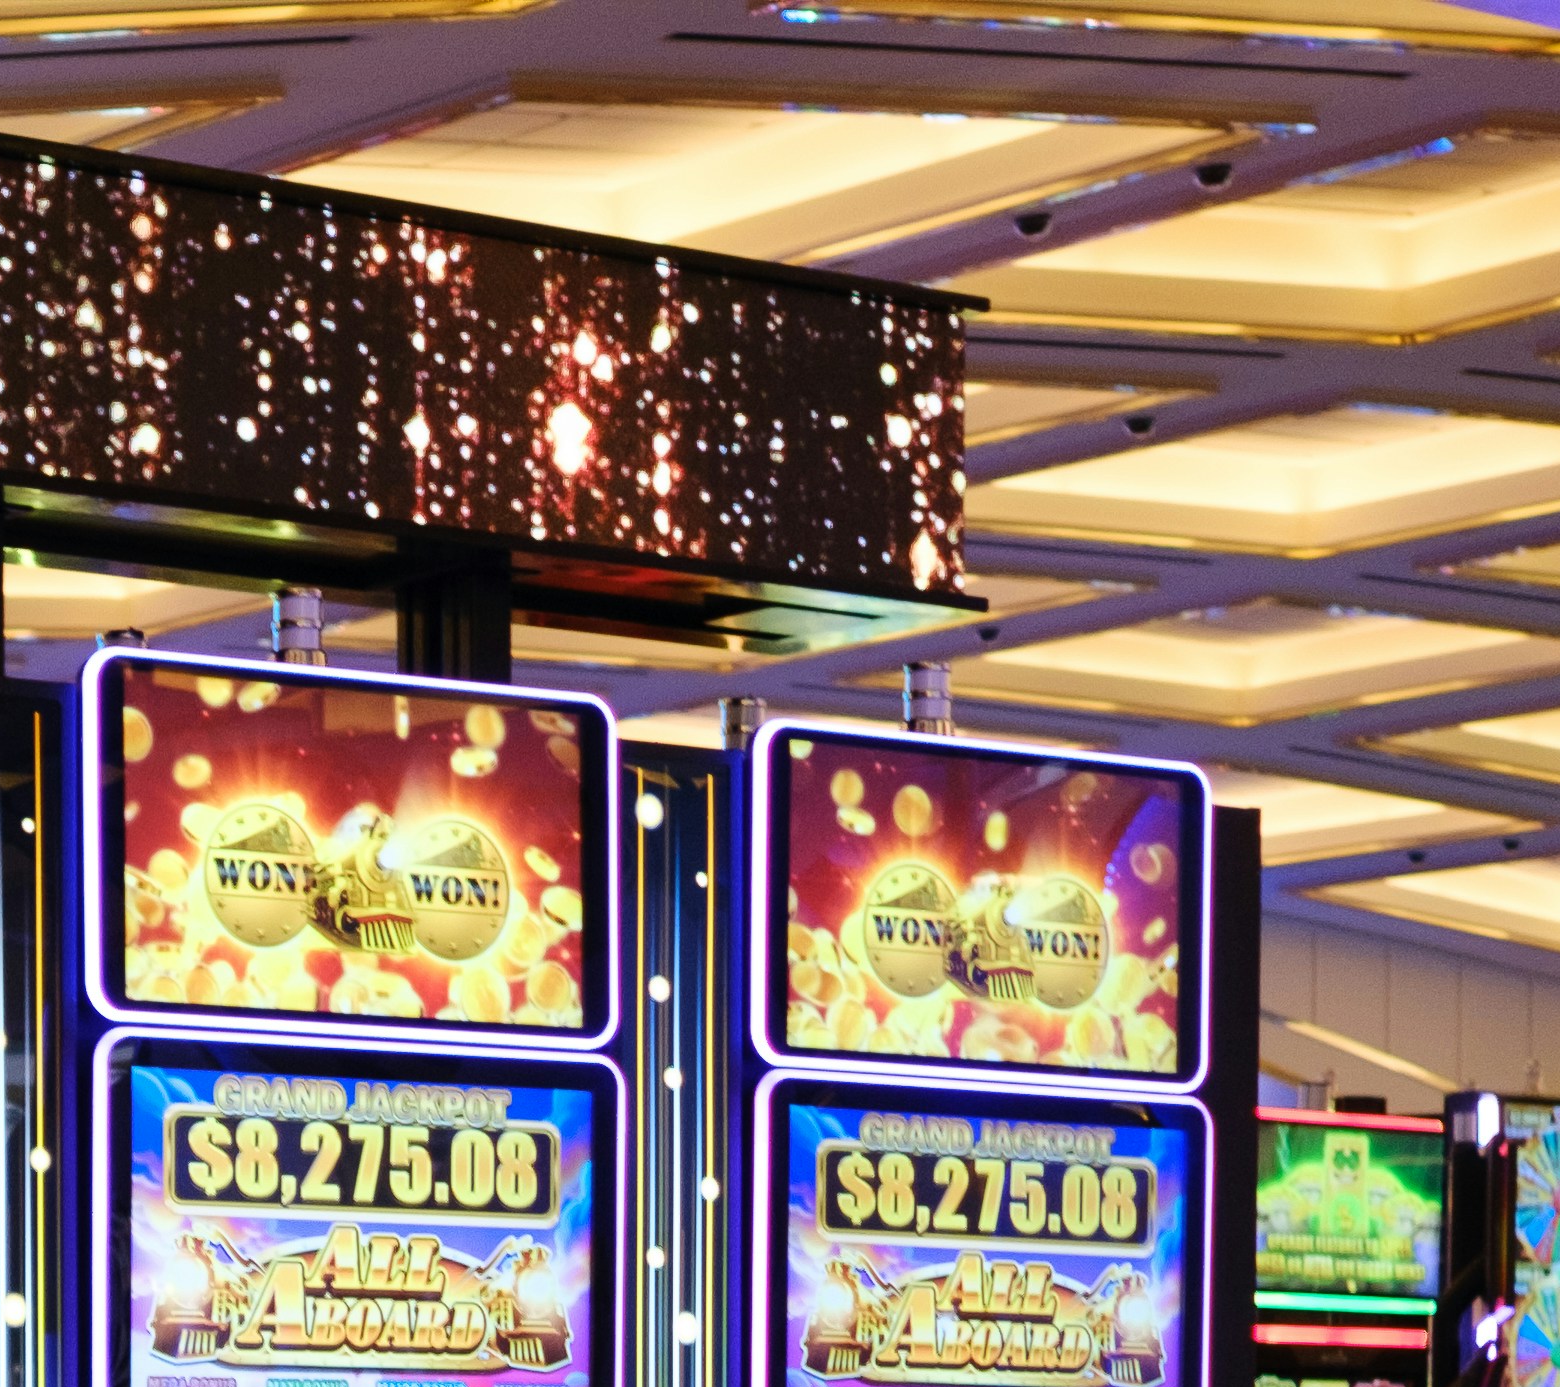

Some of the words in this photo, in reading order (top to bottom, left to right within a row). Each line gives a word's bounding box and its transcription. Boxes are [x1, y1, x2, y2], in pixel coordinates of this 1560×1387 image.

[410, 873, 501, 908] WON!
[1024, 927, 1101, 959] WON!
[215, 1075, 348, 1122] GRAND
[351, 1083, 513, 1128] JACKPOT
[860, 1113, 973, 1154] GRAND
[976, 1119, 1116, 1162] JACKPOT
[188, 1116, 538, 1209] $8,275.08
[837, 1152, 1137, 1240] $8,275.08
[305, 1223, 447, 1298] ALL
[937, 1251, 1058, 1321] ALL
[235, 1257, 487, 1353] ABOARD
[877, 1284, 1094, 1371] ABOARD
